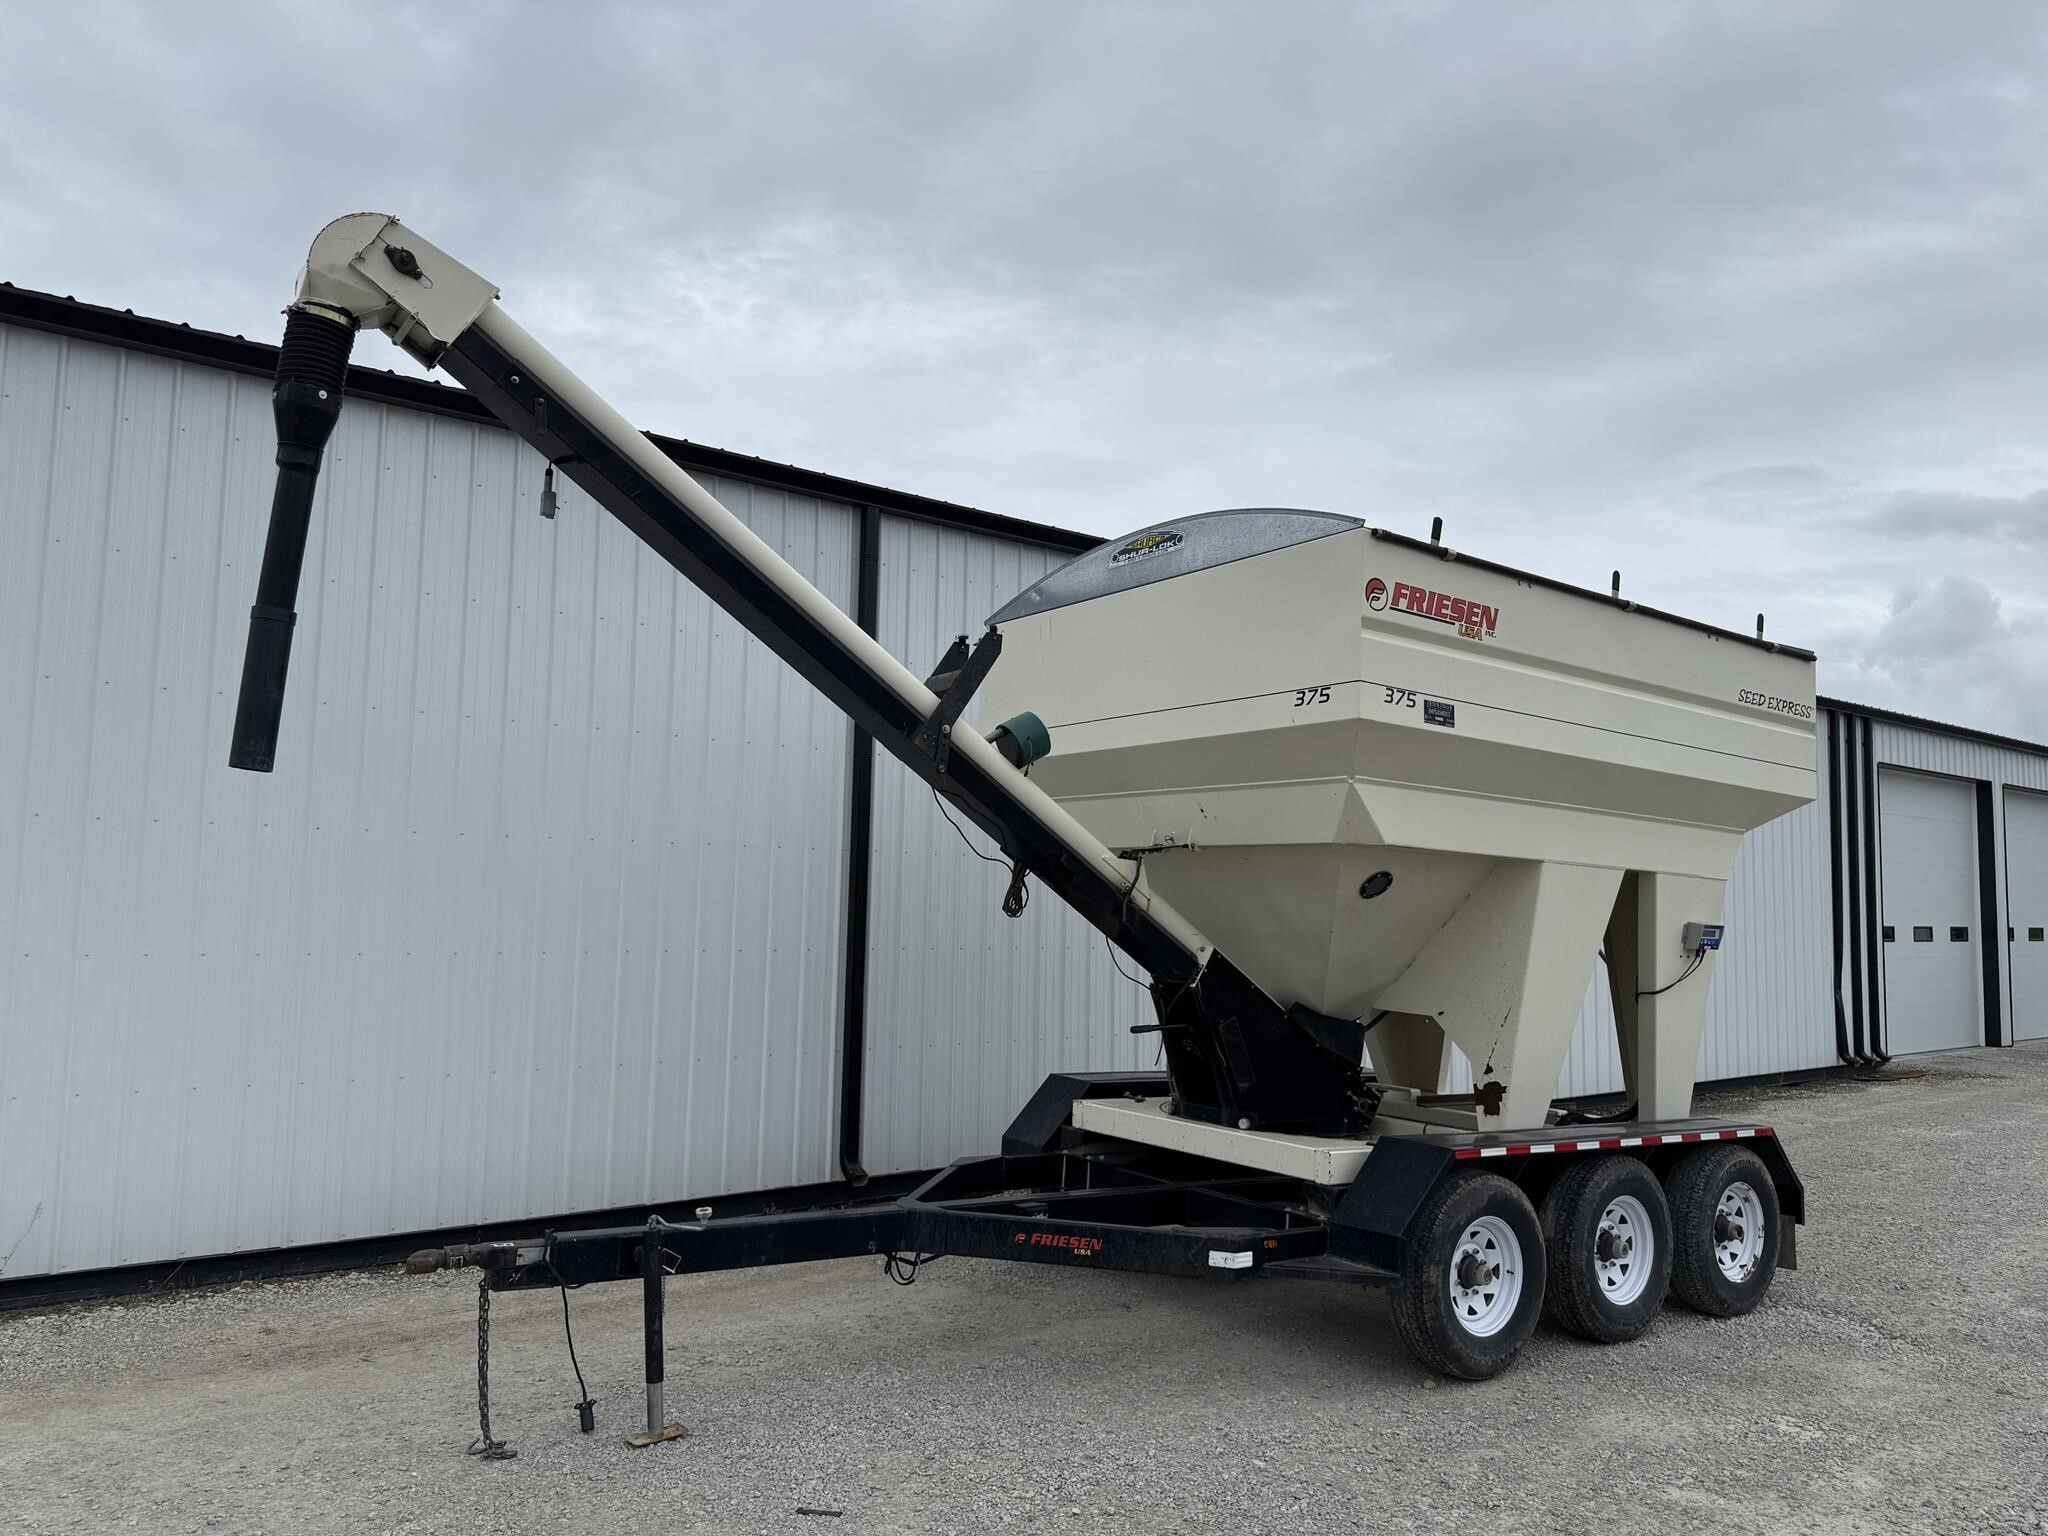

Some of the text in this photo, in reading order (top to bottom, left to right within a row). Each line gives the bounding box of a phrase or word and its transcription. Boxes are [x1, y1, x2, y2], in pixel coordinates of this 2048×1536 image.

[1118, 540, 1175, 562] SHUR-LOK
[1391, 581, 1500, 632] FRIESEN
[1457, 623, 1483, 641] USA
[1294, 686, 1332, 708] 375
[1384, 687, 1417, 708] 375
[1738, 688, 1812, 719] SEED EXPRESS
[1030, 1233, 1103, 1251] FRIESEN
[1074, 1248, 1091, 1256] USA
